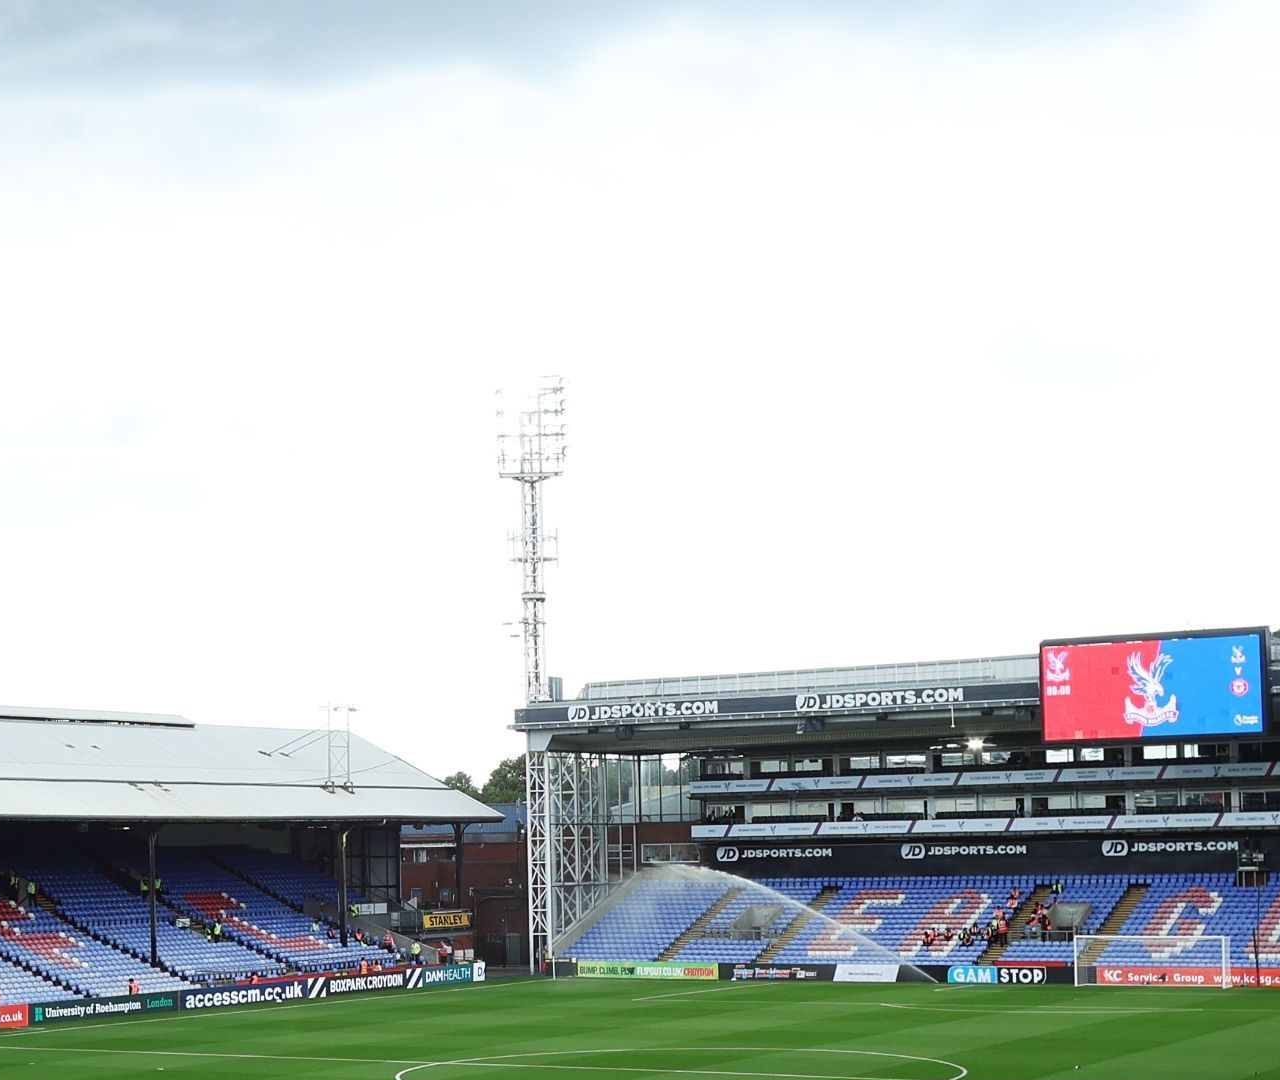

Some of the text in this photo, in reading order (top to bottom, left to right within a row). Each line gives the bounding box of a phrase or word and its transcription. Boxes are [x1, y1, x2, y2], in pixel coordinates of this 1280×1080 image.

[821, 688, 964, 709] JDSPORTS.COM
[590, 700, 719, 719] JDSPORTS.COM
[741, 848, 832, 858] JDSPORTS.COM
[927, 845, 1027, 857] JDSPORTS.COM
[1131, 841, 1239, 852] JDSPORTS.COM
[429, 914, 463, 926] STANLEY
[425, 967, 471, 983] DAMHEALTH
[953, 966, 1043, 983] GAM STOP
[1104, 969, 1123, 982] KC
[1173, 973, 1205, 984] Group
[330, 973, 403, 994] BOXPARK CROYDON
[185, 981, 303, 1009] accesscm.co.uk
[44, 998, 173, 1018] University of Roehampton London
